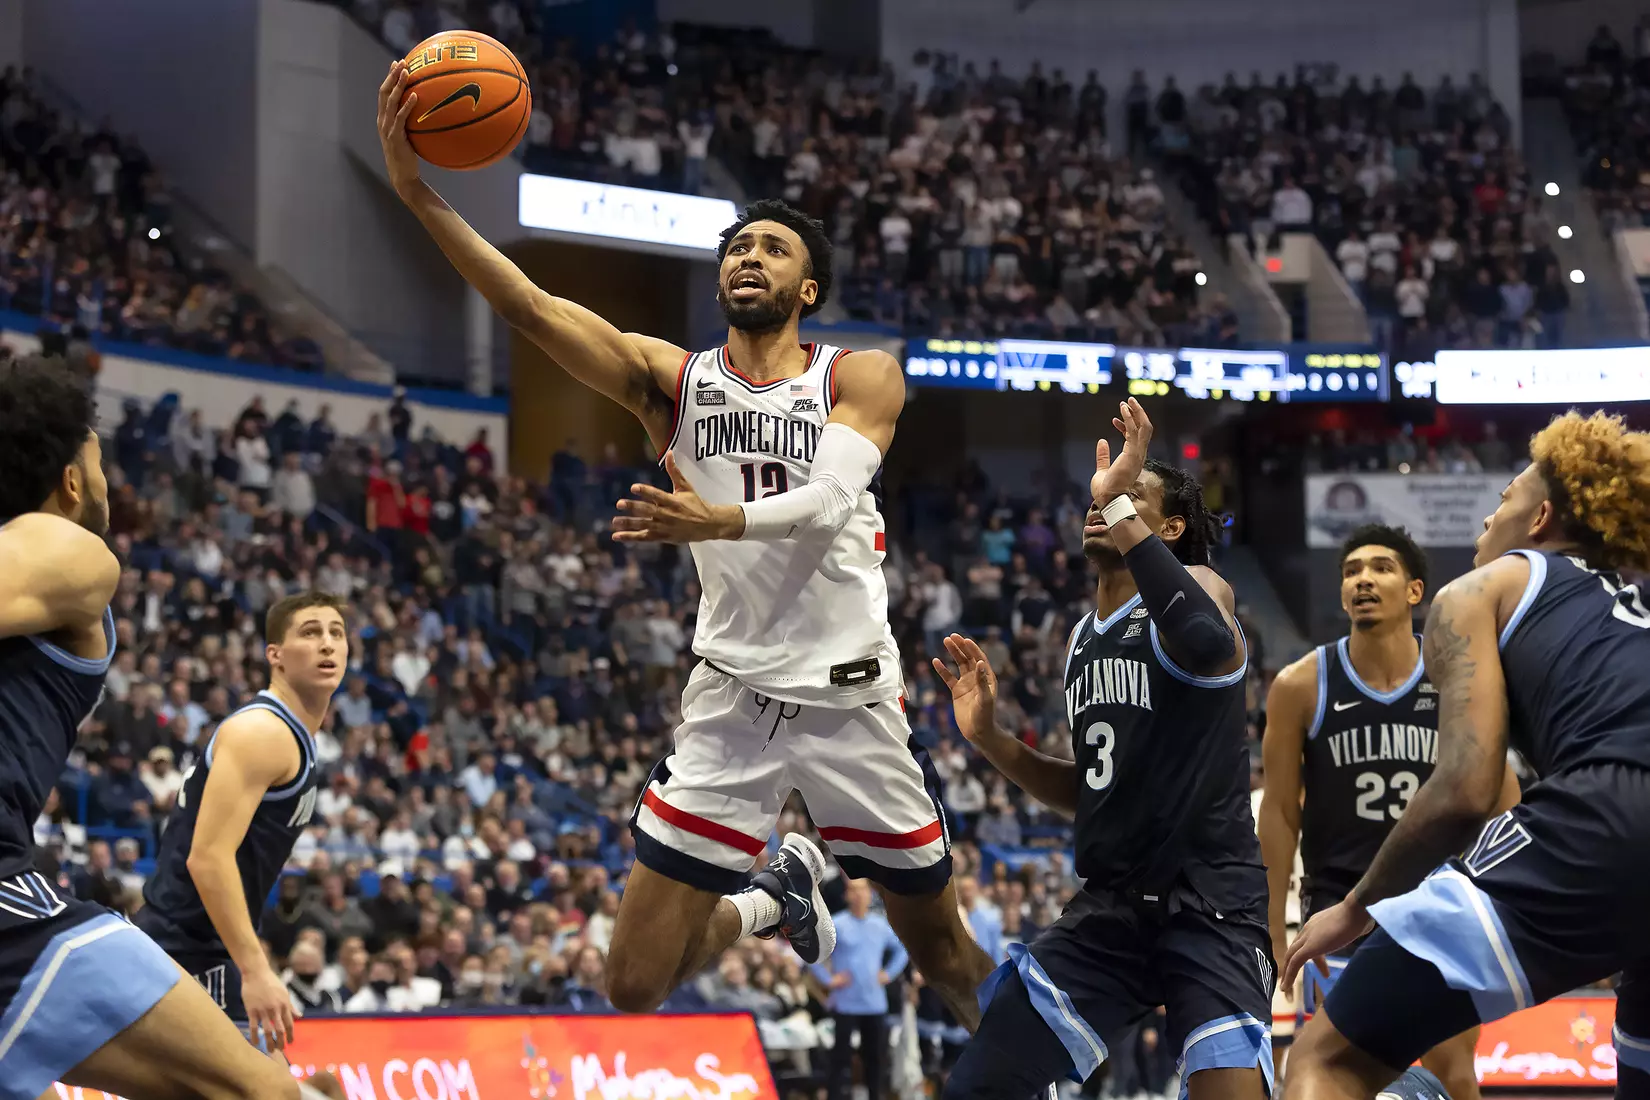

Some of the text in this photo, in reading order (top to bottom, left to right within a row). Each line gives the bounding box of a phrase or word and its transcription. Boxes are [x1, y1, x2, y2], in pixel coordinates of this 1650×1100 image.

[408, 46, 478, 75] ELITE
[792, 403, 819, 411] EAST
[1085, 721, 1116, 791] 3
[1355, 771, 1420, 822] 23
